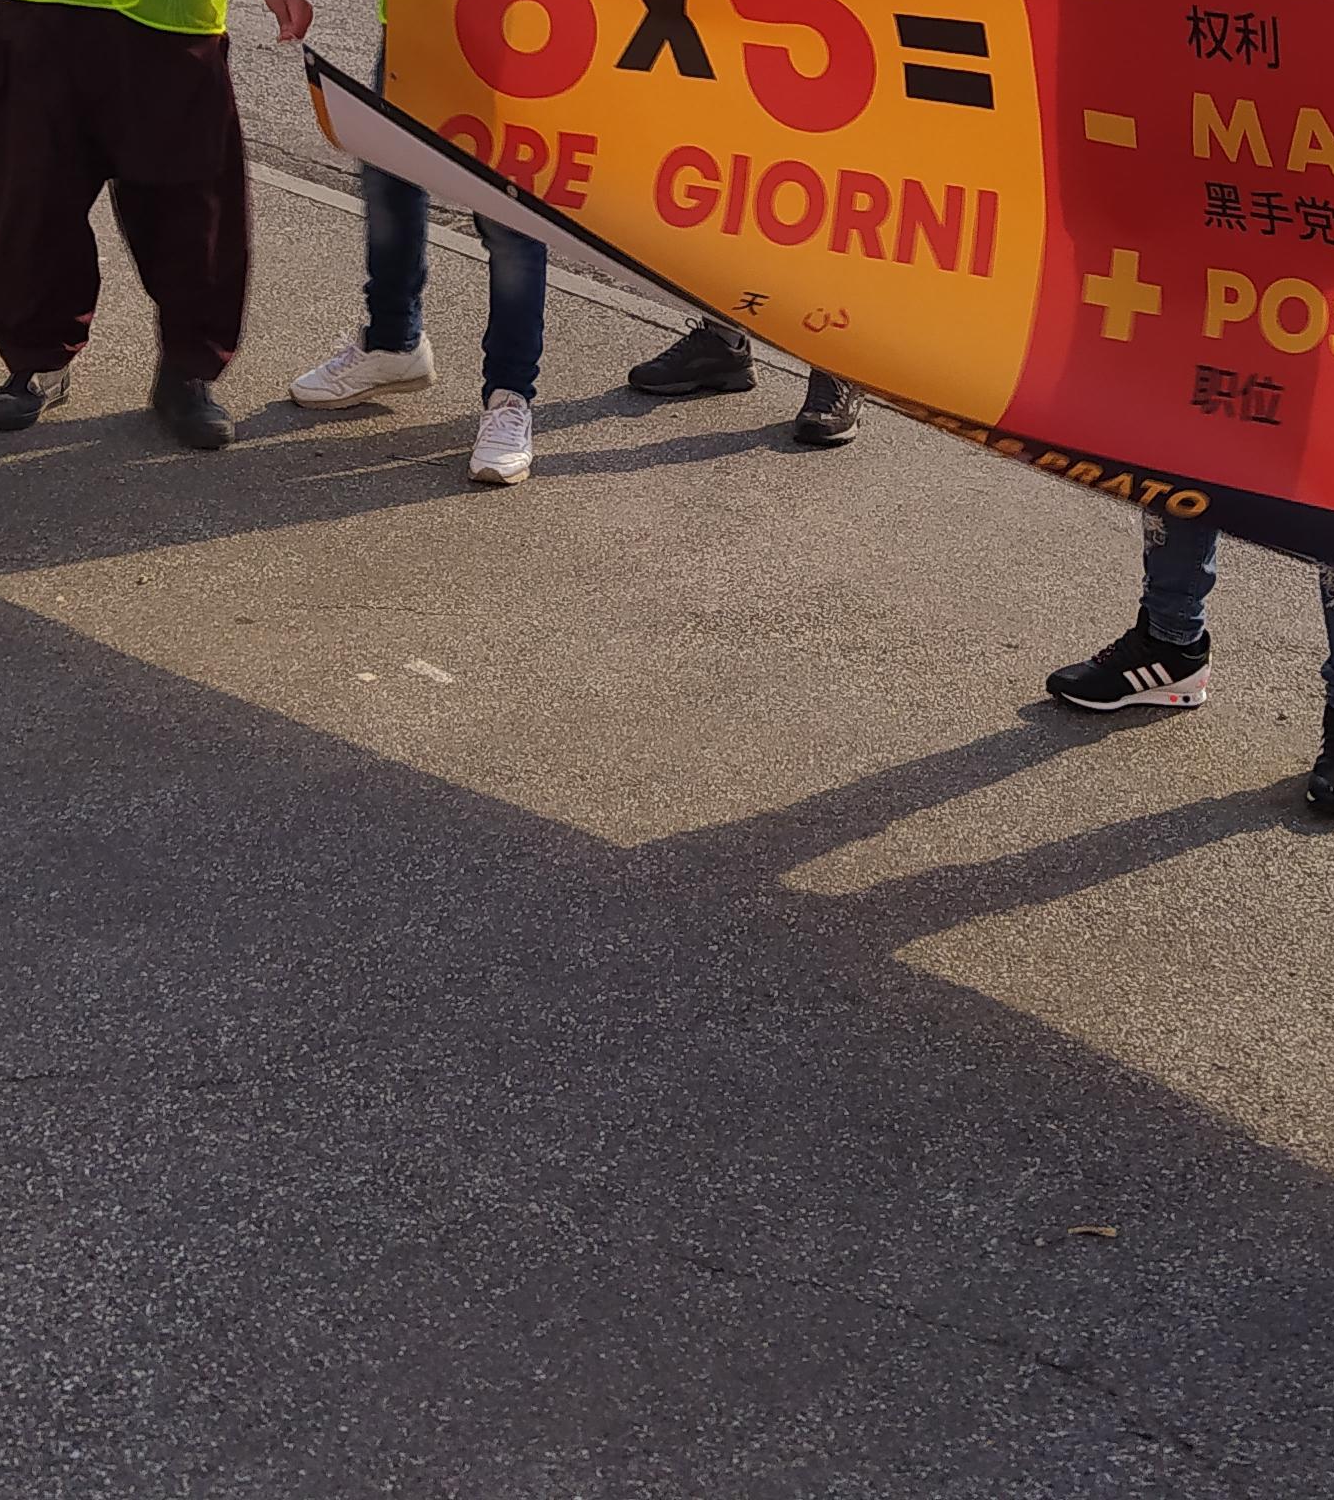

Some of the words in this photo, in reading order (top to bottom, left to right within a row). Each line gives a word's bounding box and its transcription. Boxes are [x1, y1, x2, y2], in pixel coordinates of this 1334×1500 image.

[1185, 4, 1281, 70] 权利
[652, 143, 1000, 279] GIORNI
[730, 290, 771, 317] 天
[1188, 363, 1285, 427] 职位
